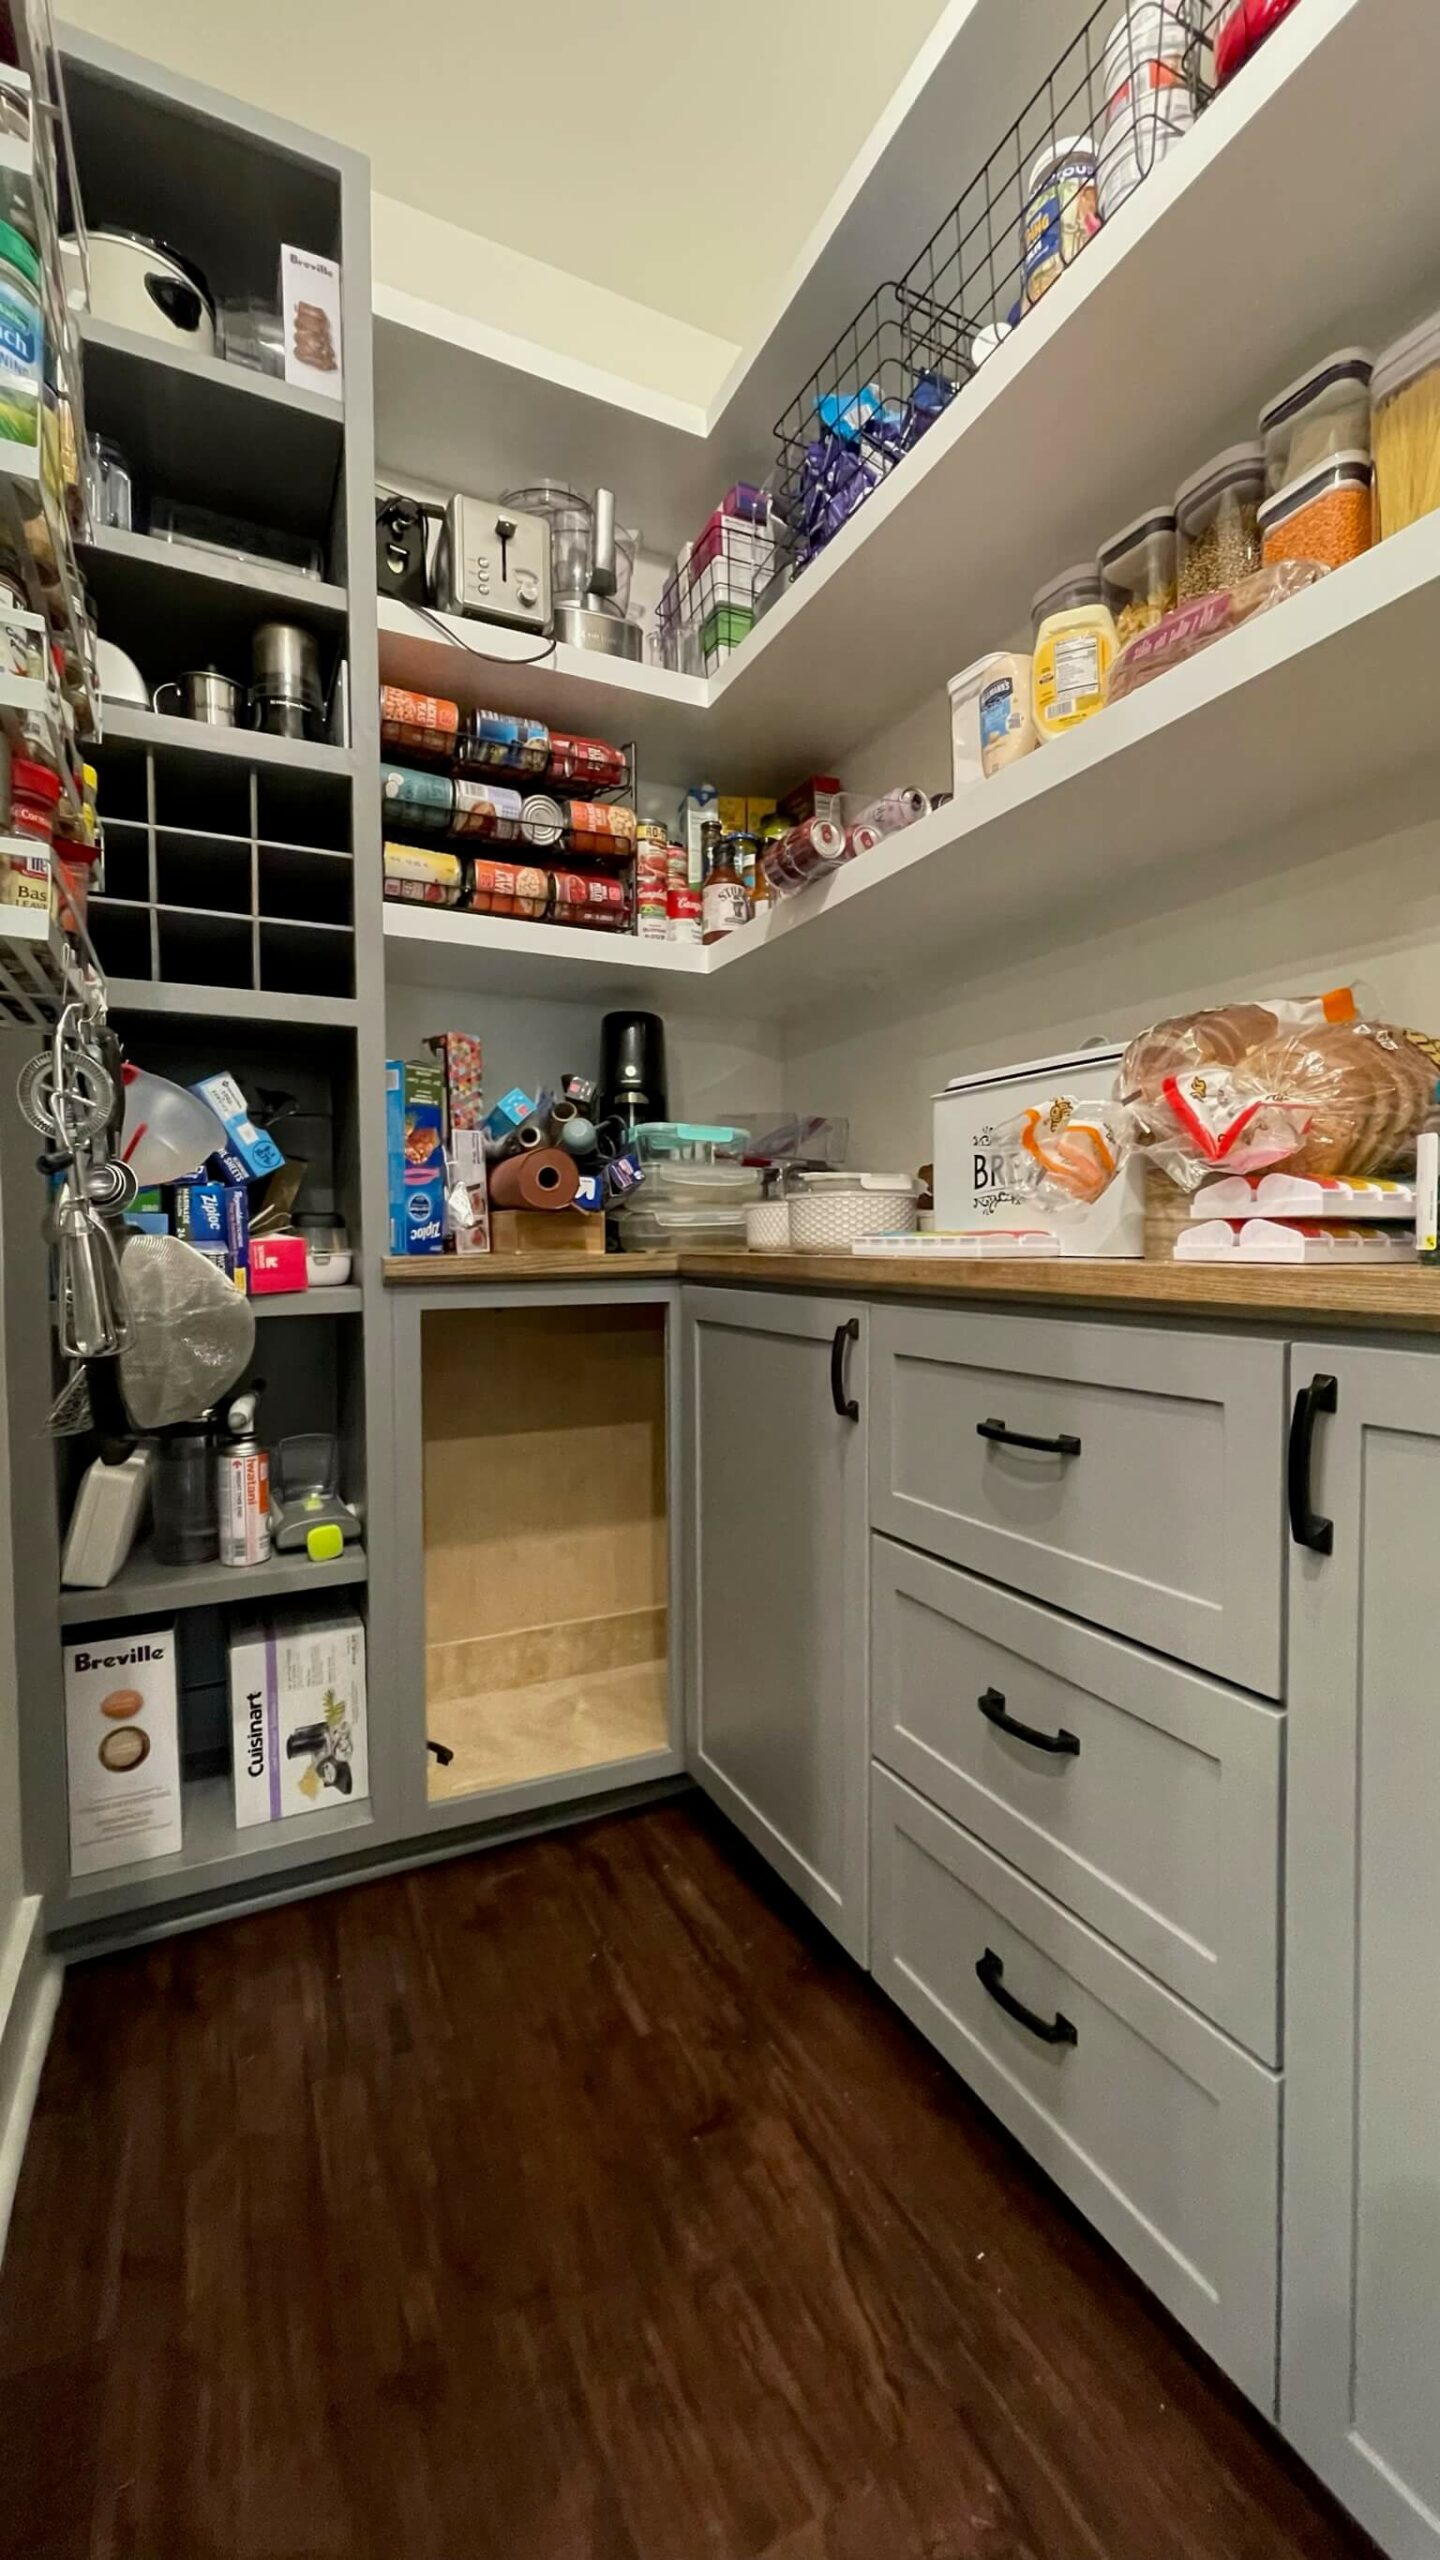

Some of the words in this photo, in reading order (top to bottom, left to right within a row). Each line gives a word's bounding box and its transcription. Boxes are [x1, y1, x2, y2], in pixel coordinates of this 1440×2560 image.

[18, 885, 47, 902] Bas
[200, 1193, 221, 1231] Ziploc
[410, 1221, 441, 1241] Ziploc
[75, 1645, 165, 1672] Breville
[246, 1691, 264, 1778] Cuisinart
